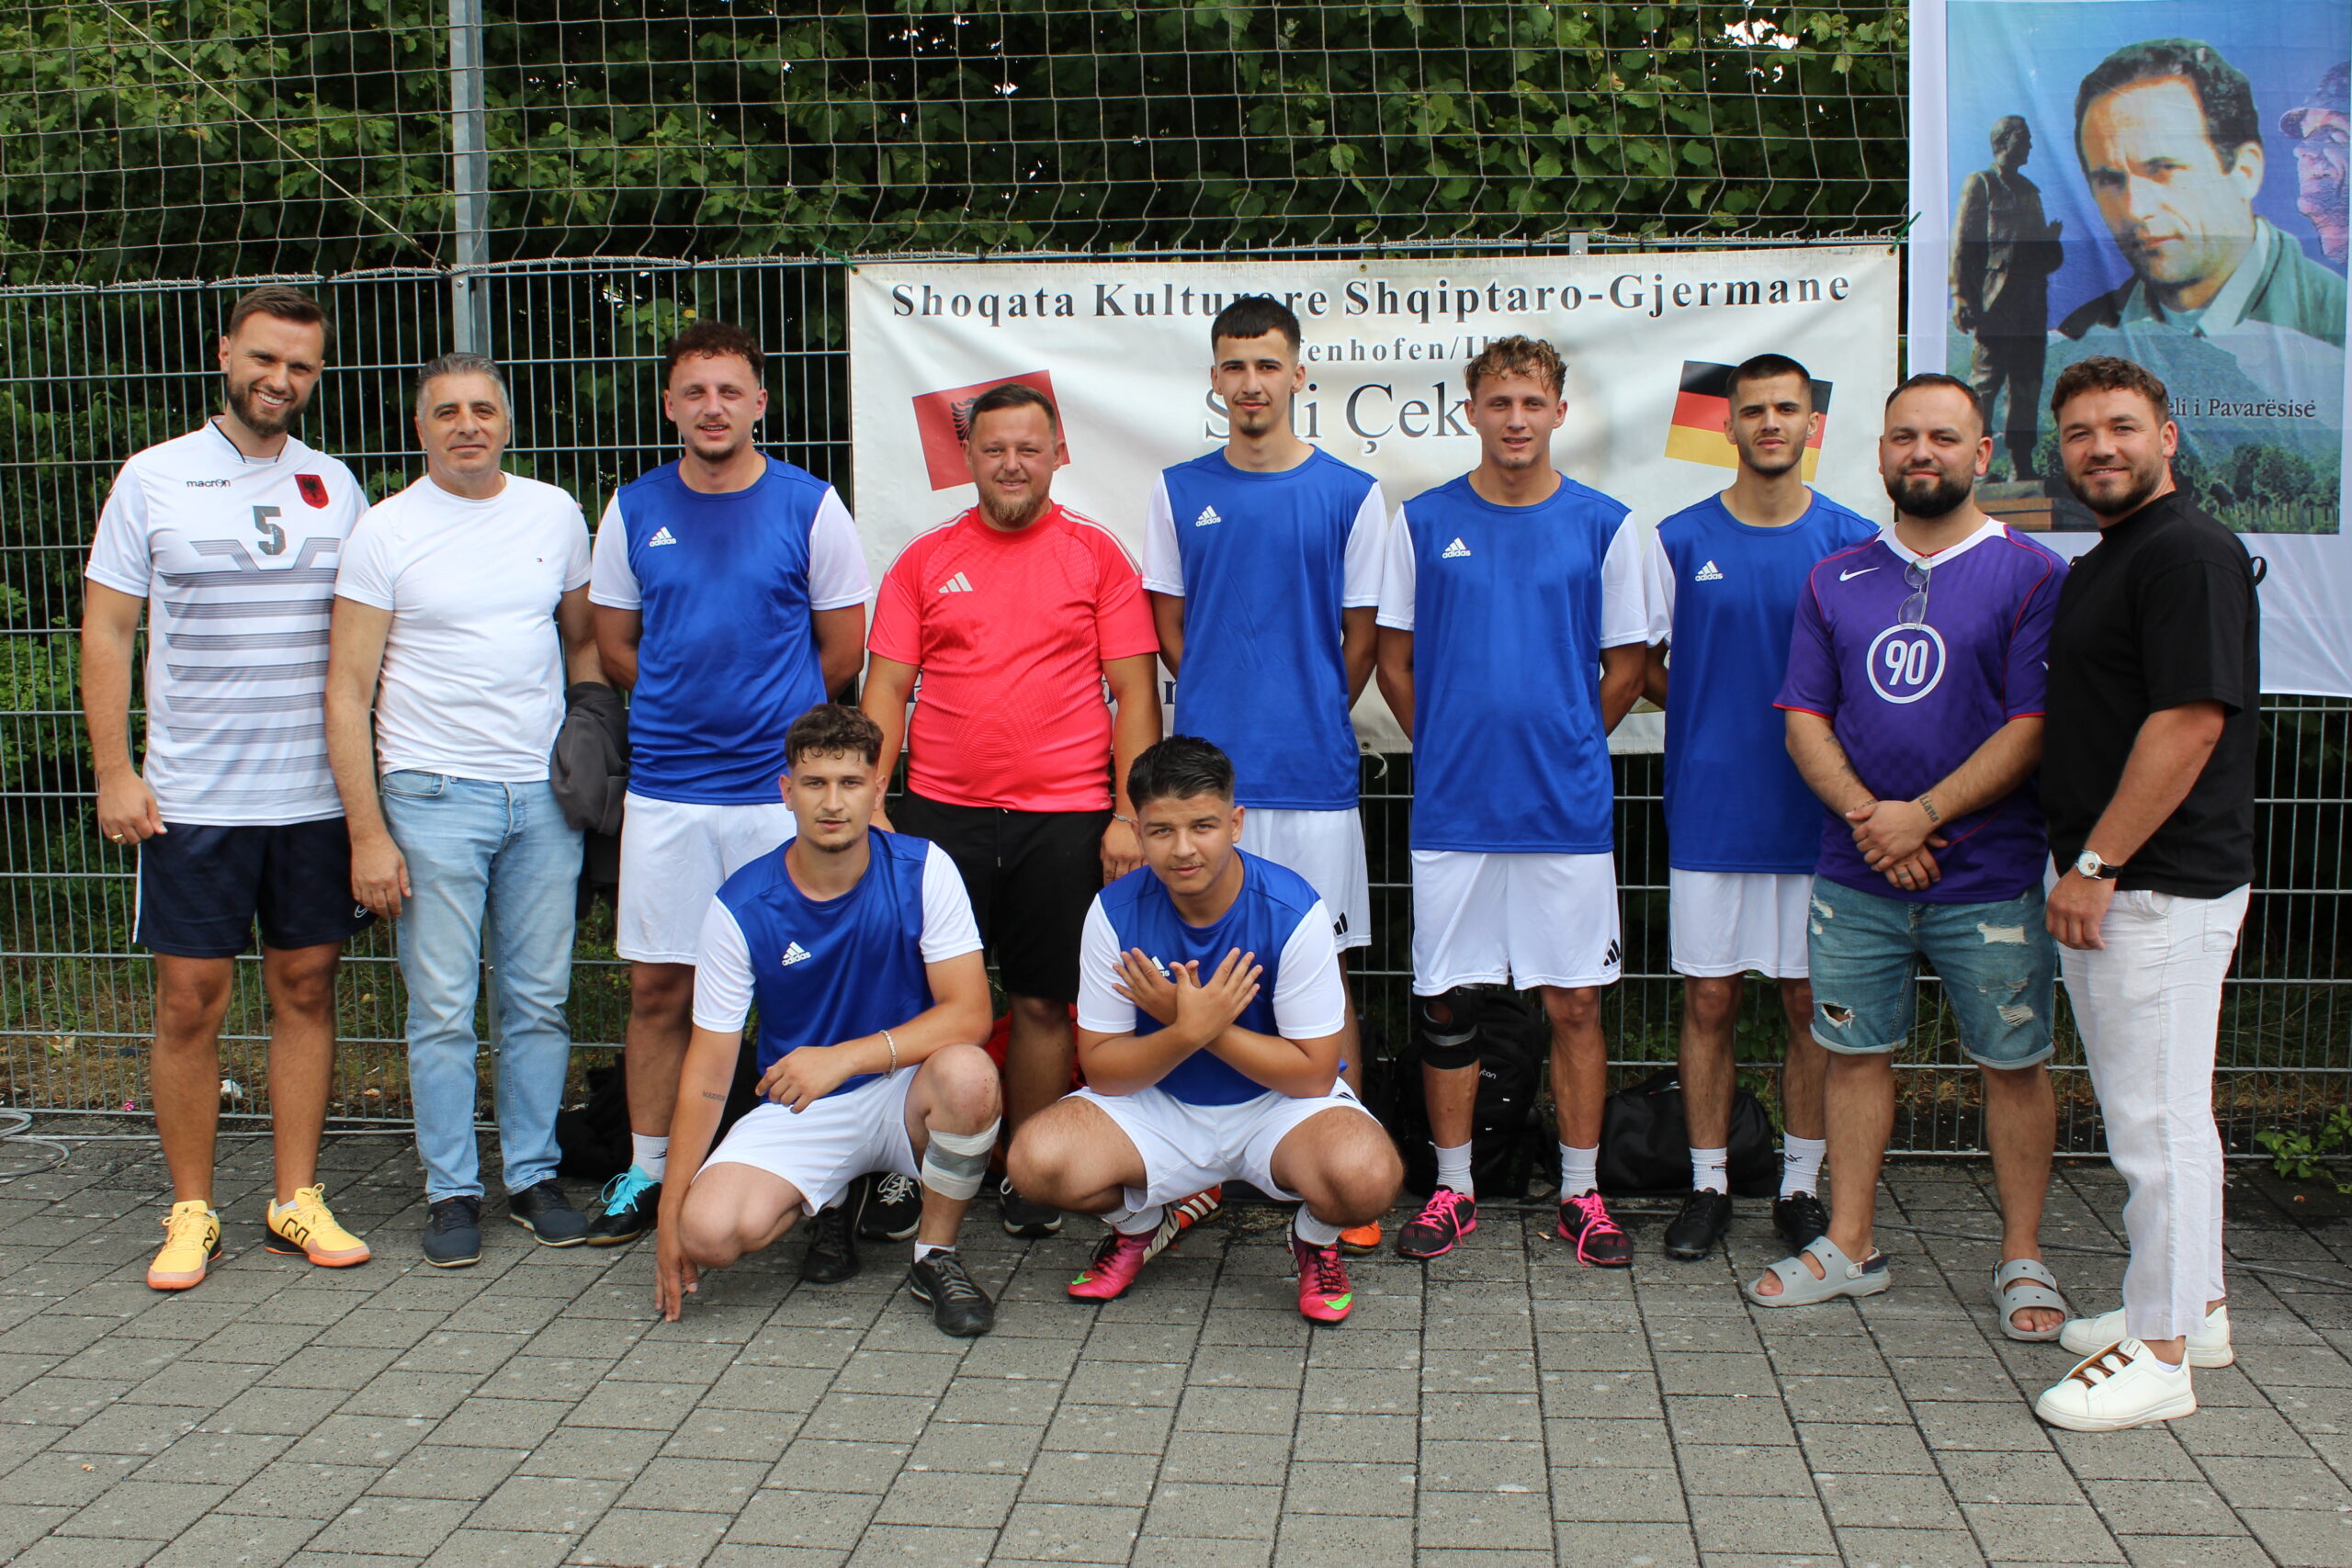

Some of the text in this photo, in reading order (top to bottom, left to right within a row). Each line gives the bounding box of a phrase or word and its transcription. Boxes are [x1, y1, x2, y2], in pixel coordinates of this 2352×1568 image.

[892, 284, 1075, 328] Shoqata
[1345, 273, 1849, 324] Shqiptaro-Gjermane
[2194, 399, 2201, 417] i
[1205, 381, 1472, 454] Sli Çek
[187, 479, 232, 488] macron
[1195, 516, 1222, 527] adidas
[253, 505, 287, 556] 5
[649, 537, 677, 547] adidas
[1442, 549, 1471, 558] adidas
[1694, 572, 1724, 581] adidas
[1884, 639, 1928, 686] 90
[781, 951, 812, 966] adidas
